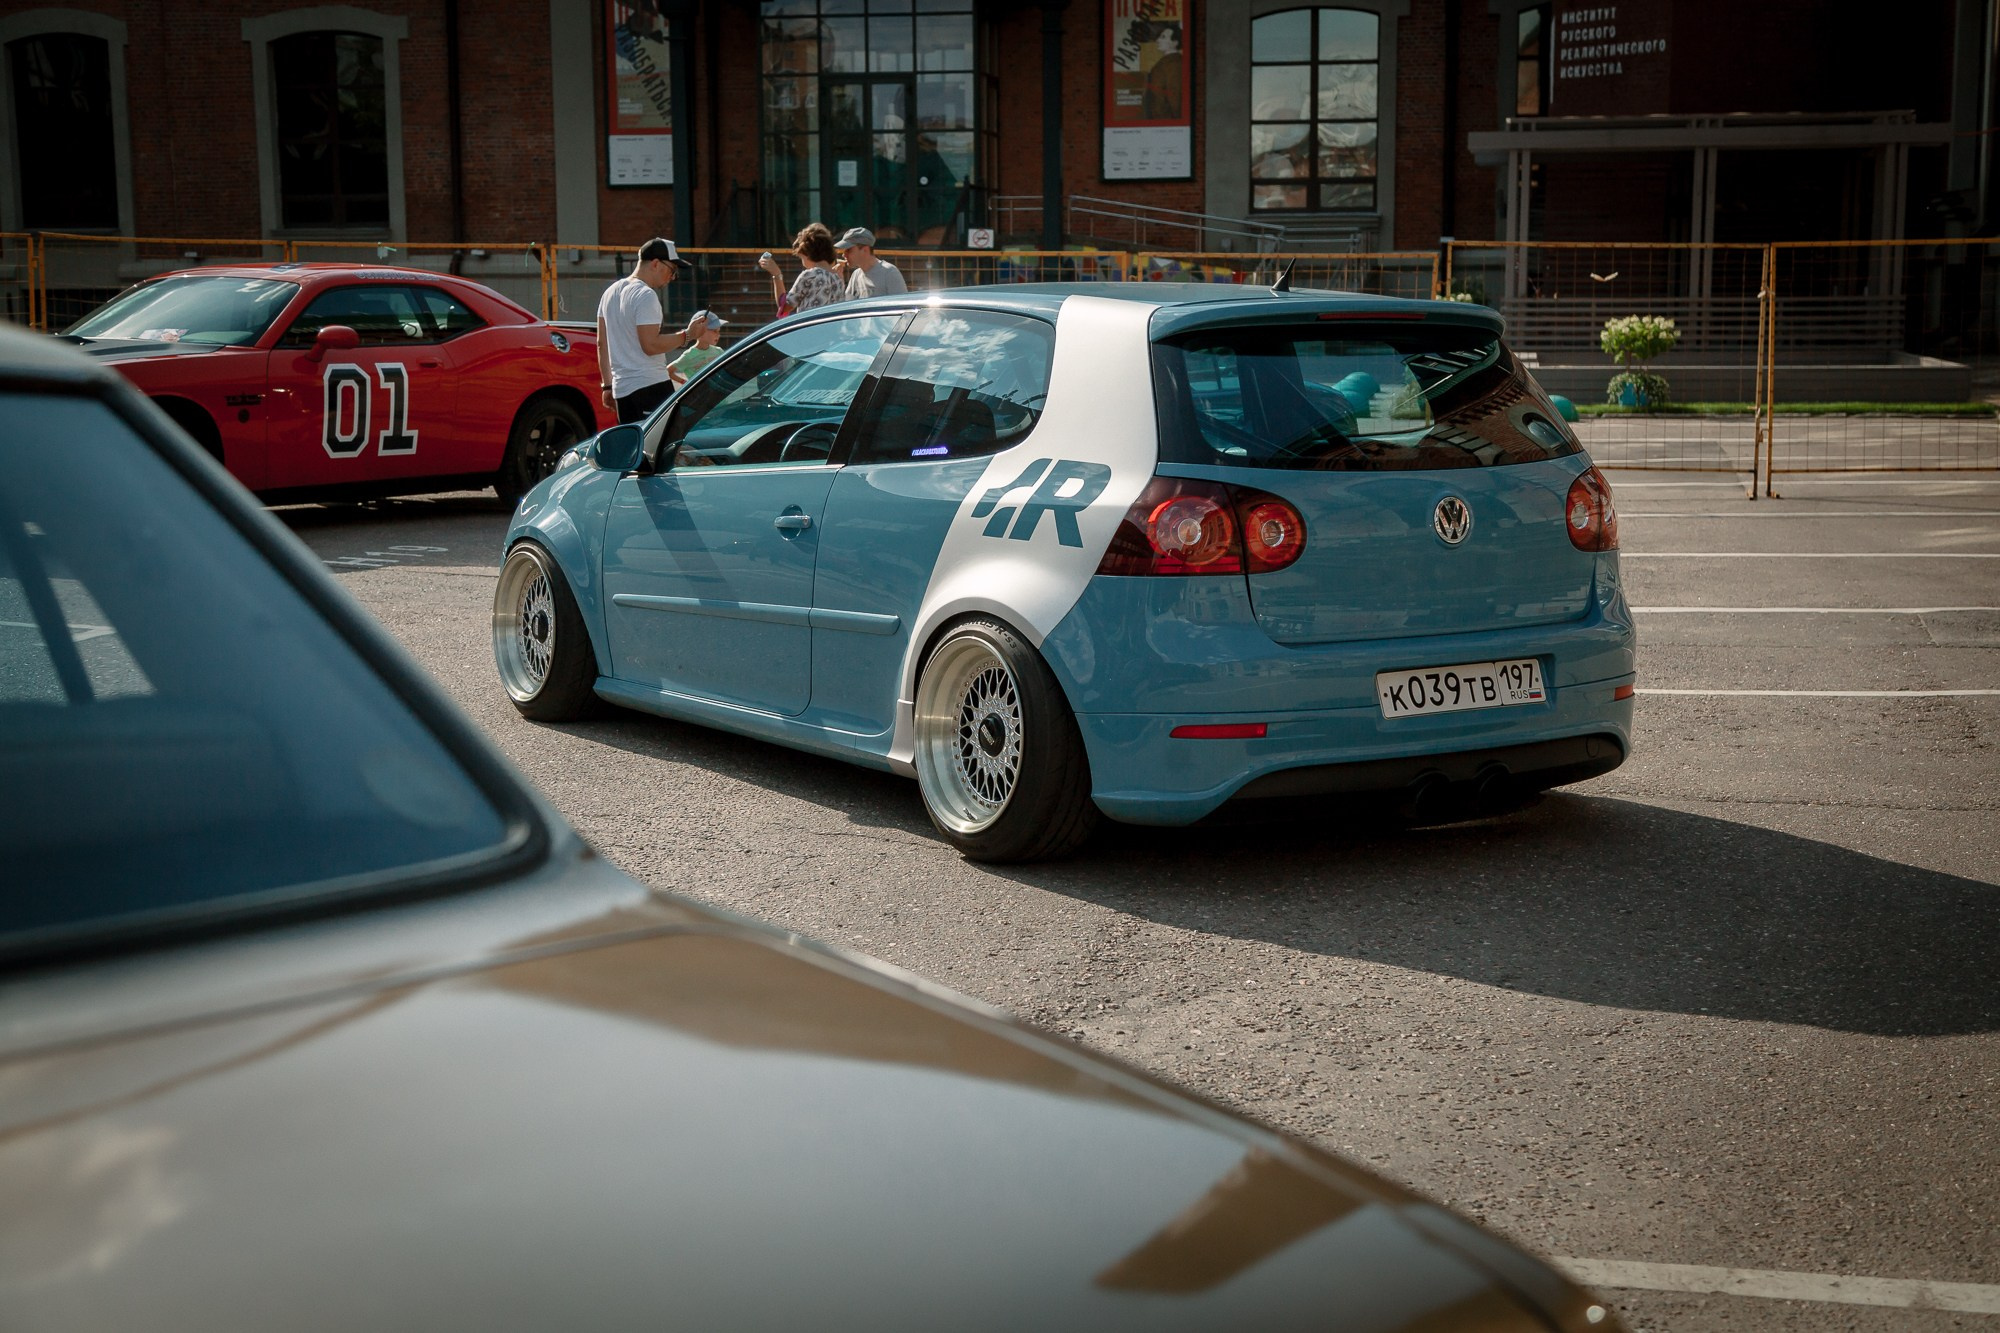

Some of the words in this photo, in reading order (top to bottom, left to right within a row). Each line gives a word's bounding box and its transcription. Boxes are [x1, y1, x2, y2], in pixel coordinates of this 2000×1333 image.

[1561, 7, 1617, 24] ИНСТИТУТ
[1561, 26, 1616, 43] РУССКОГО
[1560, 39, 1666, 61] РЕАЛИСТИЧЕСКОГО
[1560, 62, 1623, 79] ИСКУССТВА
[322, 362, 419, 459] 01
[1435, 498, 1469, 543] VW
[1499, 663, 1533, 690] 197
[1510, 689, 1529, 699] RUS
